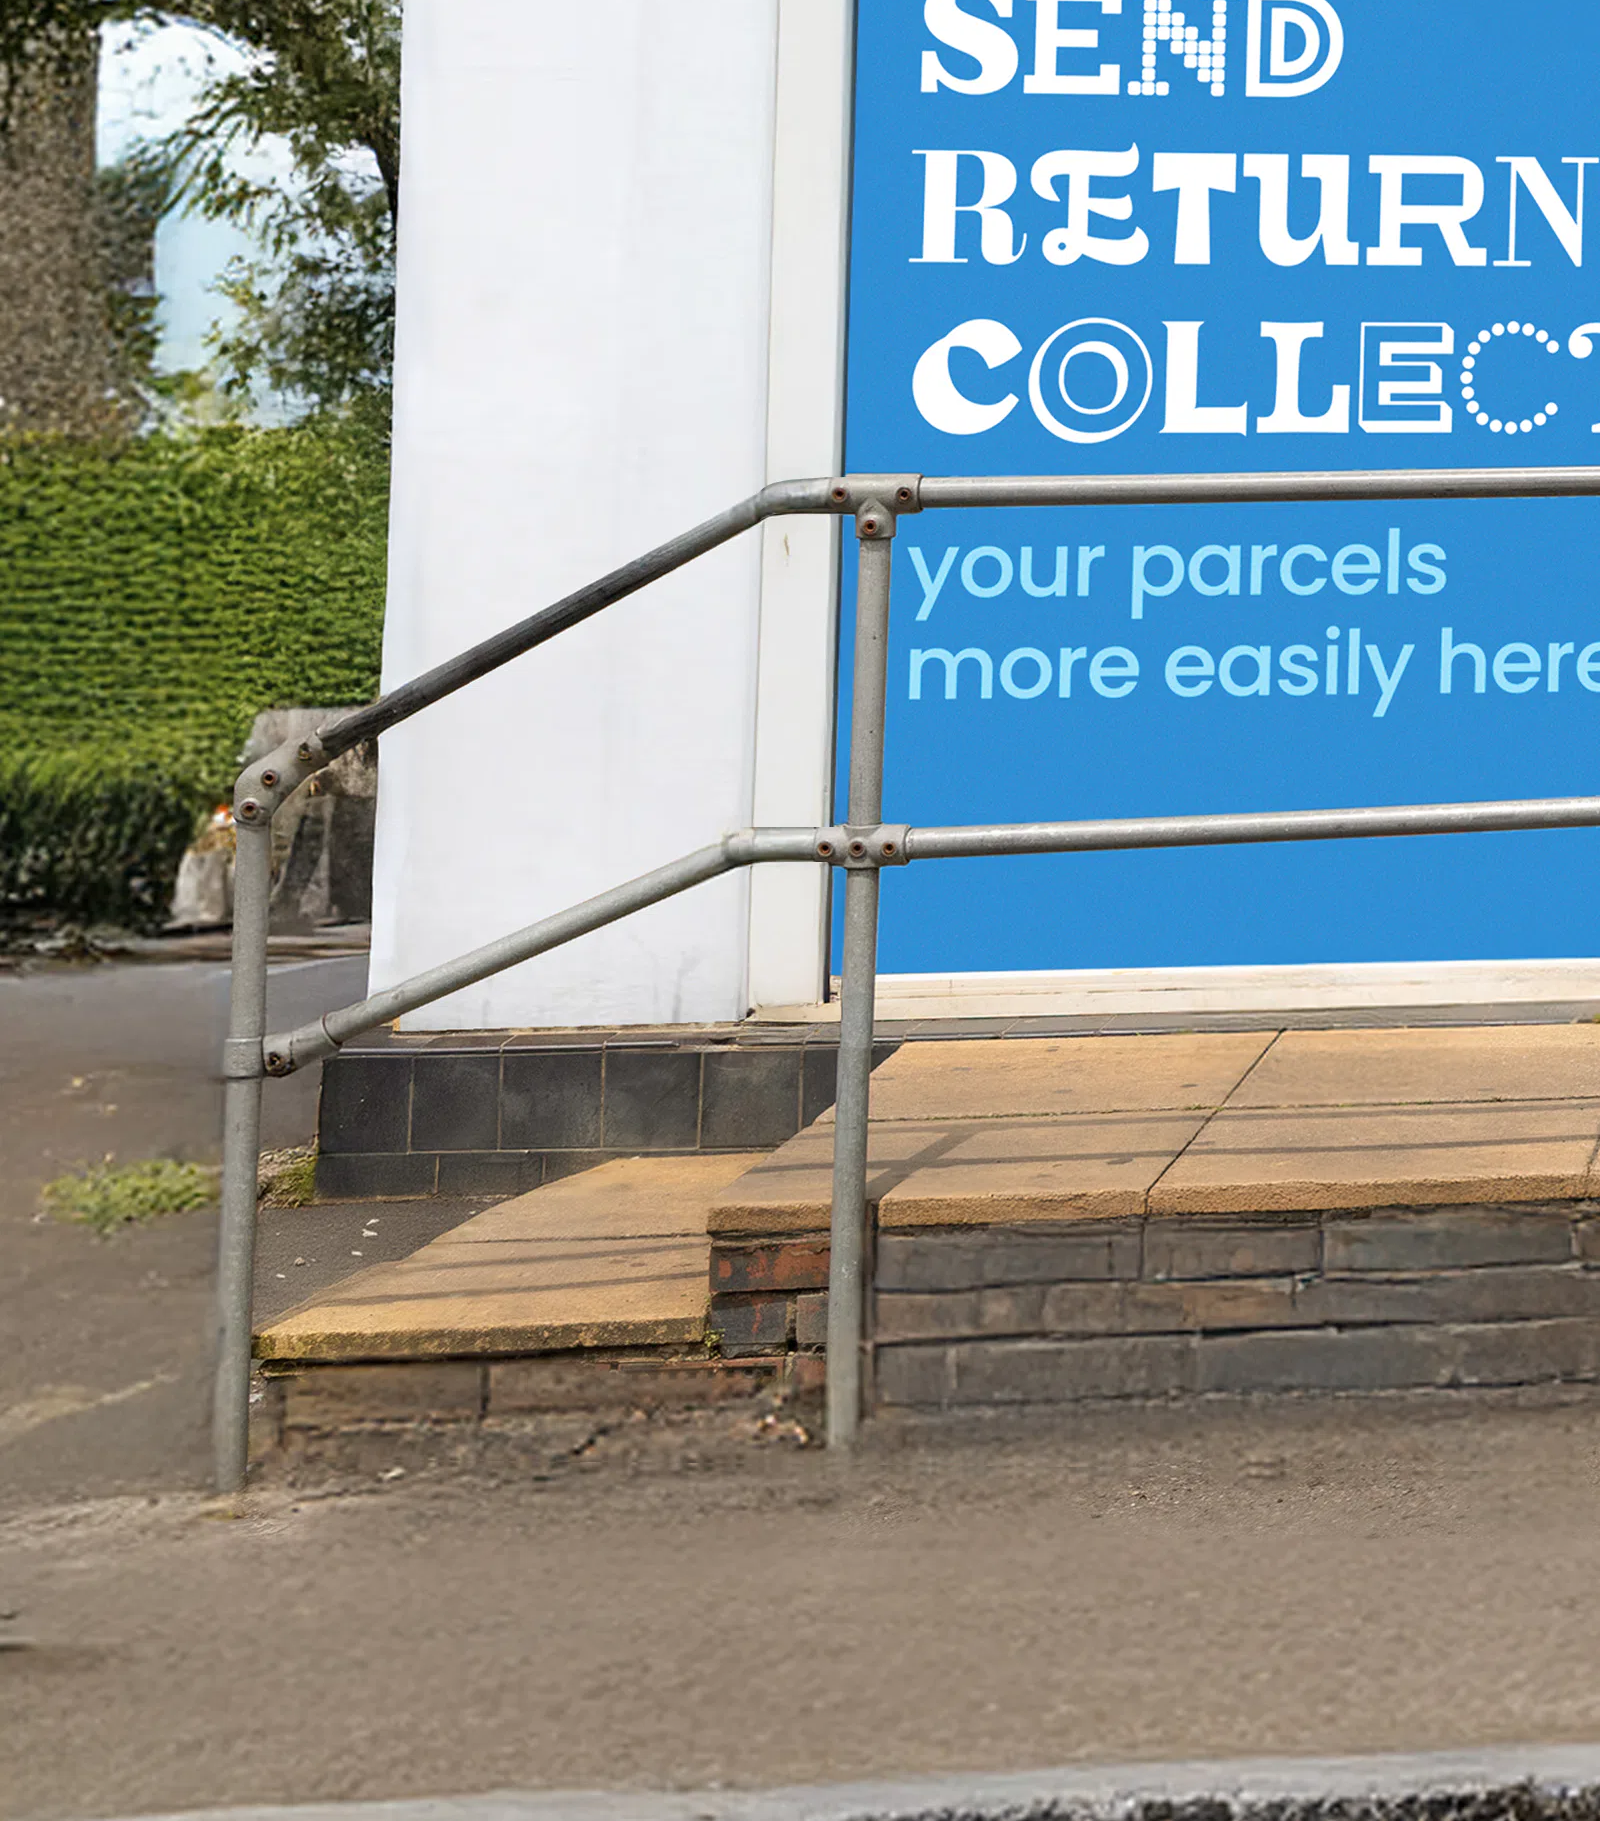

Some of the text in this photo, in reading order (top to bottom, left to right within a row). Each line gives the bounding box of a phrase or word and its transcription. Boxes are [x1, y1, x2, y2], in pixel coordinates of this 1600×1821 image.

[908, 142, 1600, 268] RETURN
[906, 527, 1447, 622] your parcels
[907, 646, 1140, 700] more
[1164, 625, 1415, 718] easily
